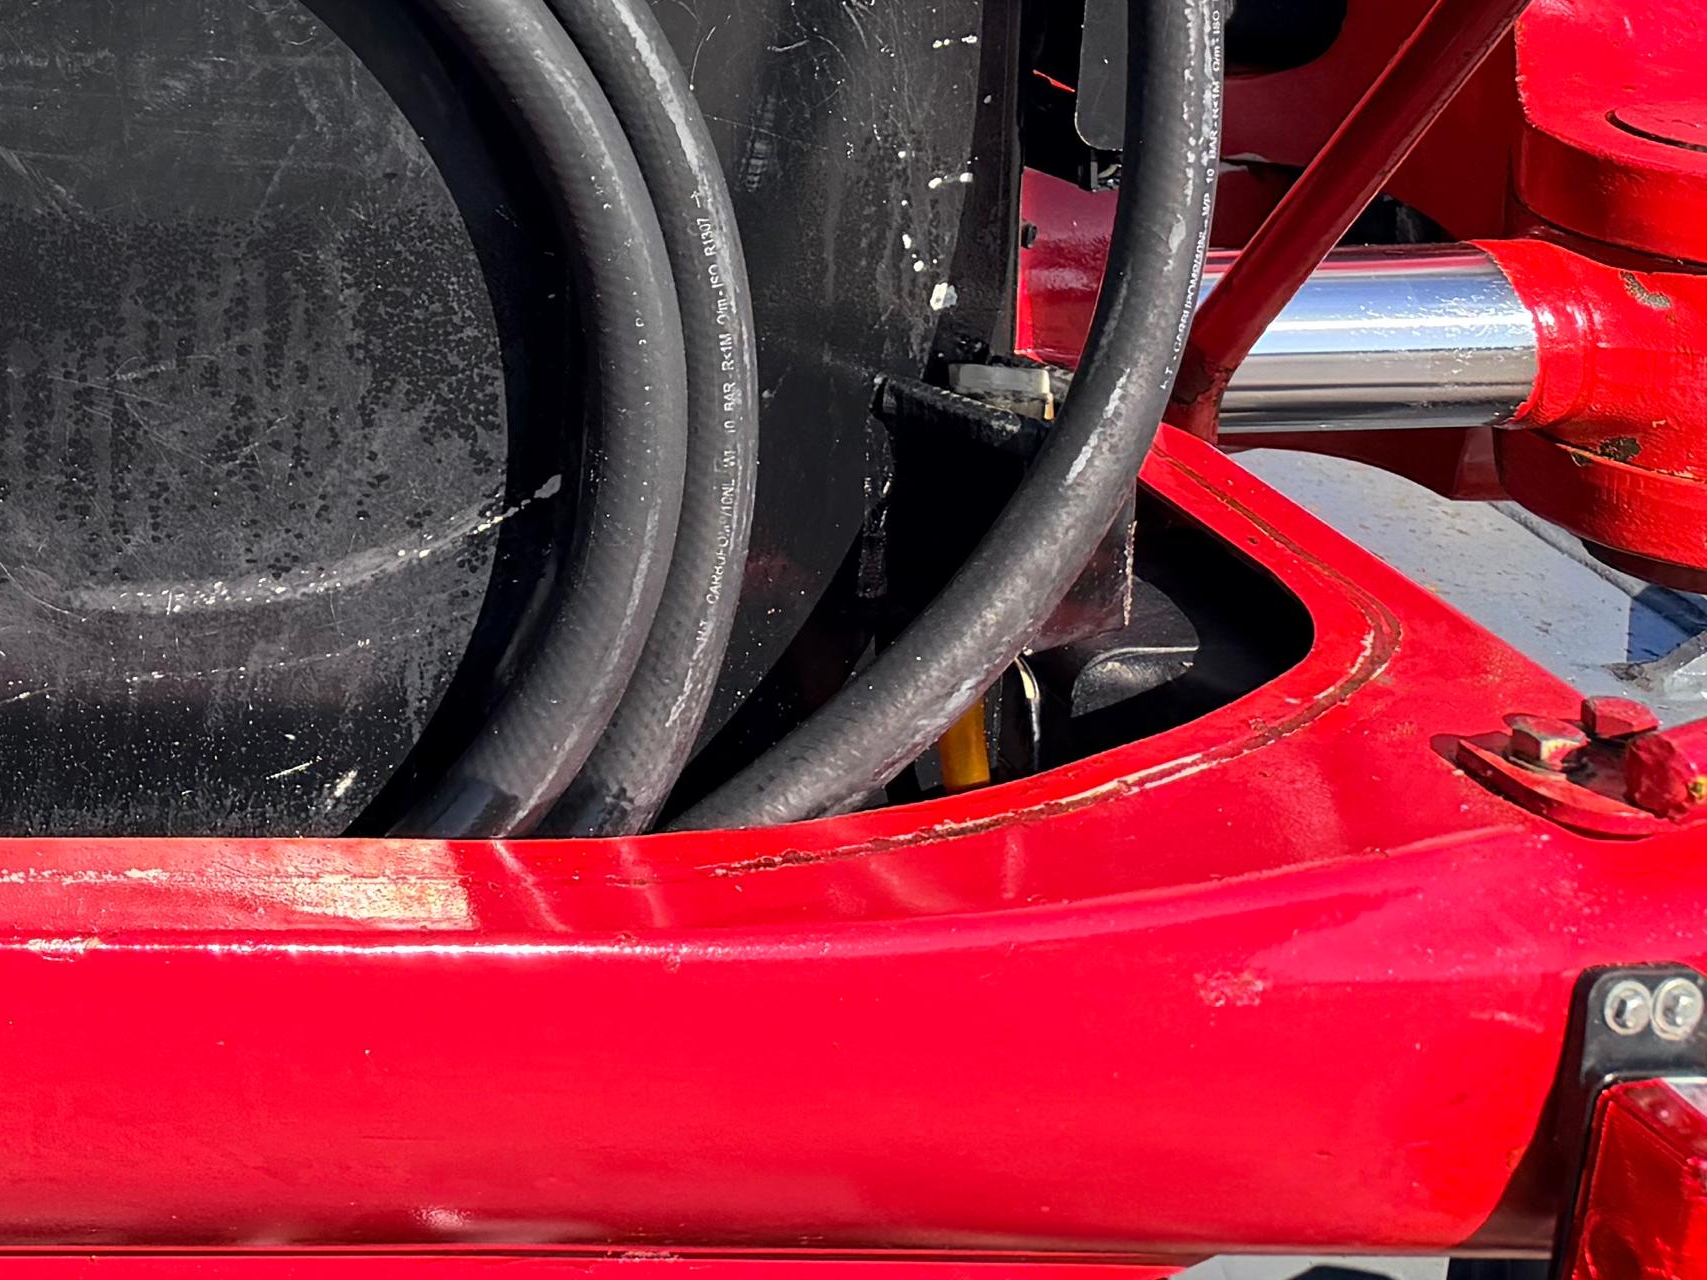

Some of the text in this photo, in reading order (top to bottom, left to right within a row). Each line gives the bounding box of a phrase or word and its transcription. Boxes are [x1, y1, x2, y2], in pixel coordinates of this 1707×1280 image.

[697, 217, 716, 256] R1307
[708, 264, 724, 288] ISO
[718, 333, 735, 370] R<1M
